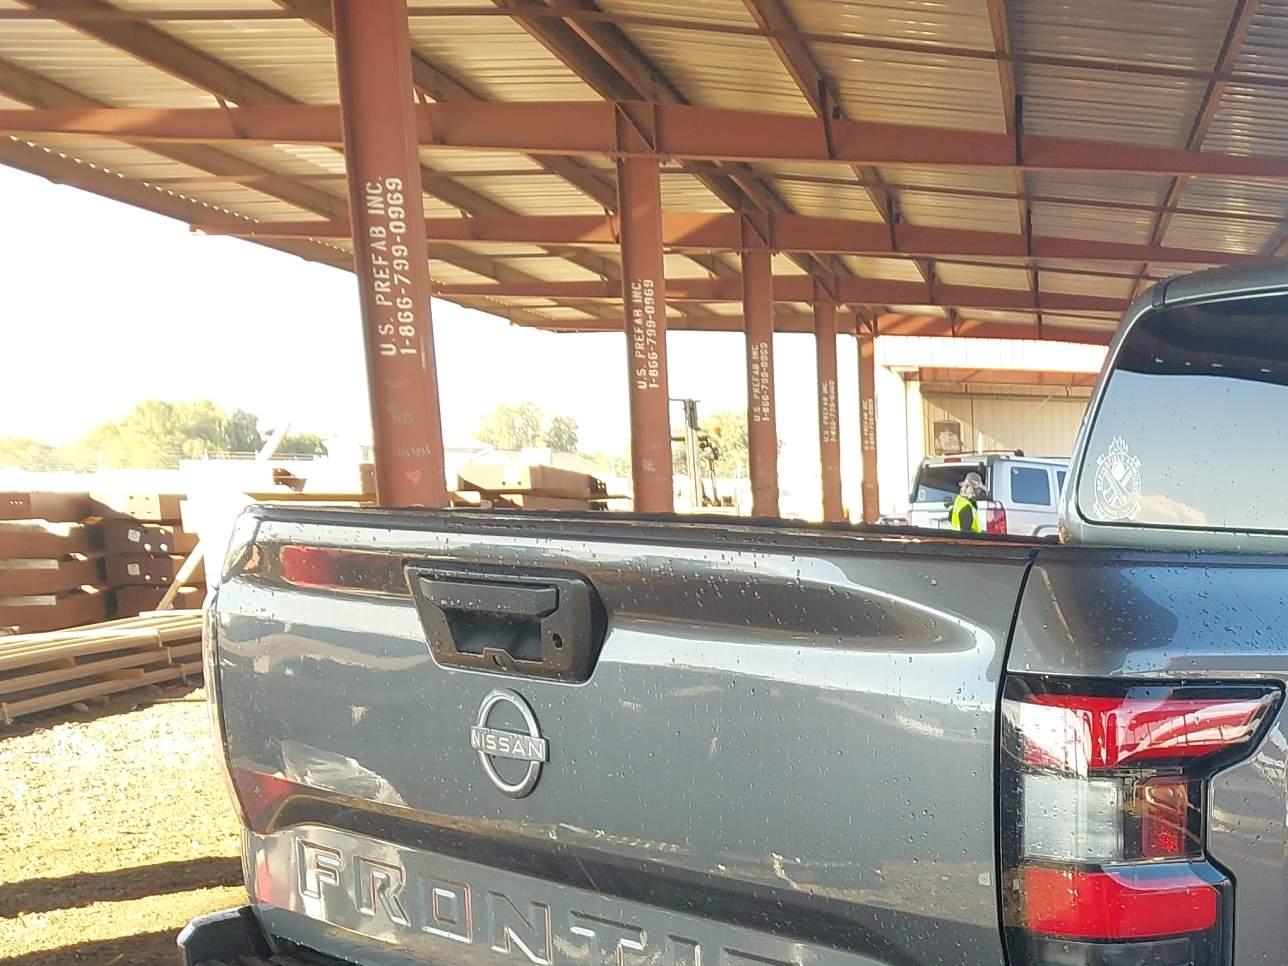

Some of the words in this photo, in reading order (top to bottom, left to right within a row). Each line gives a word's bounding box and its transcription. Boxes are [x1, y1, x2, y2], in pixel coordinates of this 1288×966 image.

[366, 176, 385, 215] INC.
[370, 225, 393, 306] PREFAB
[385, 177, 417, 355] 1-866-799-0969
[379, 317, 398, 357] U.S.
[633, 308, 645, 359] PREFAB
[643, 279, 659, 388] 1-866-799-0969
[471, 728, 544, 760] NISSAN
